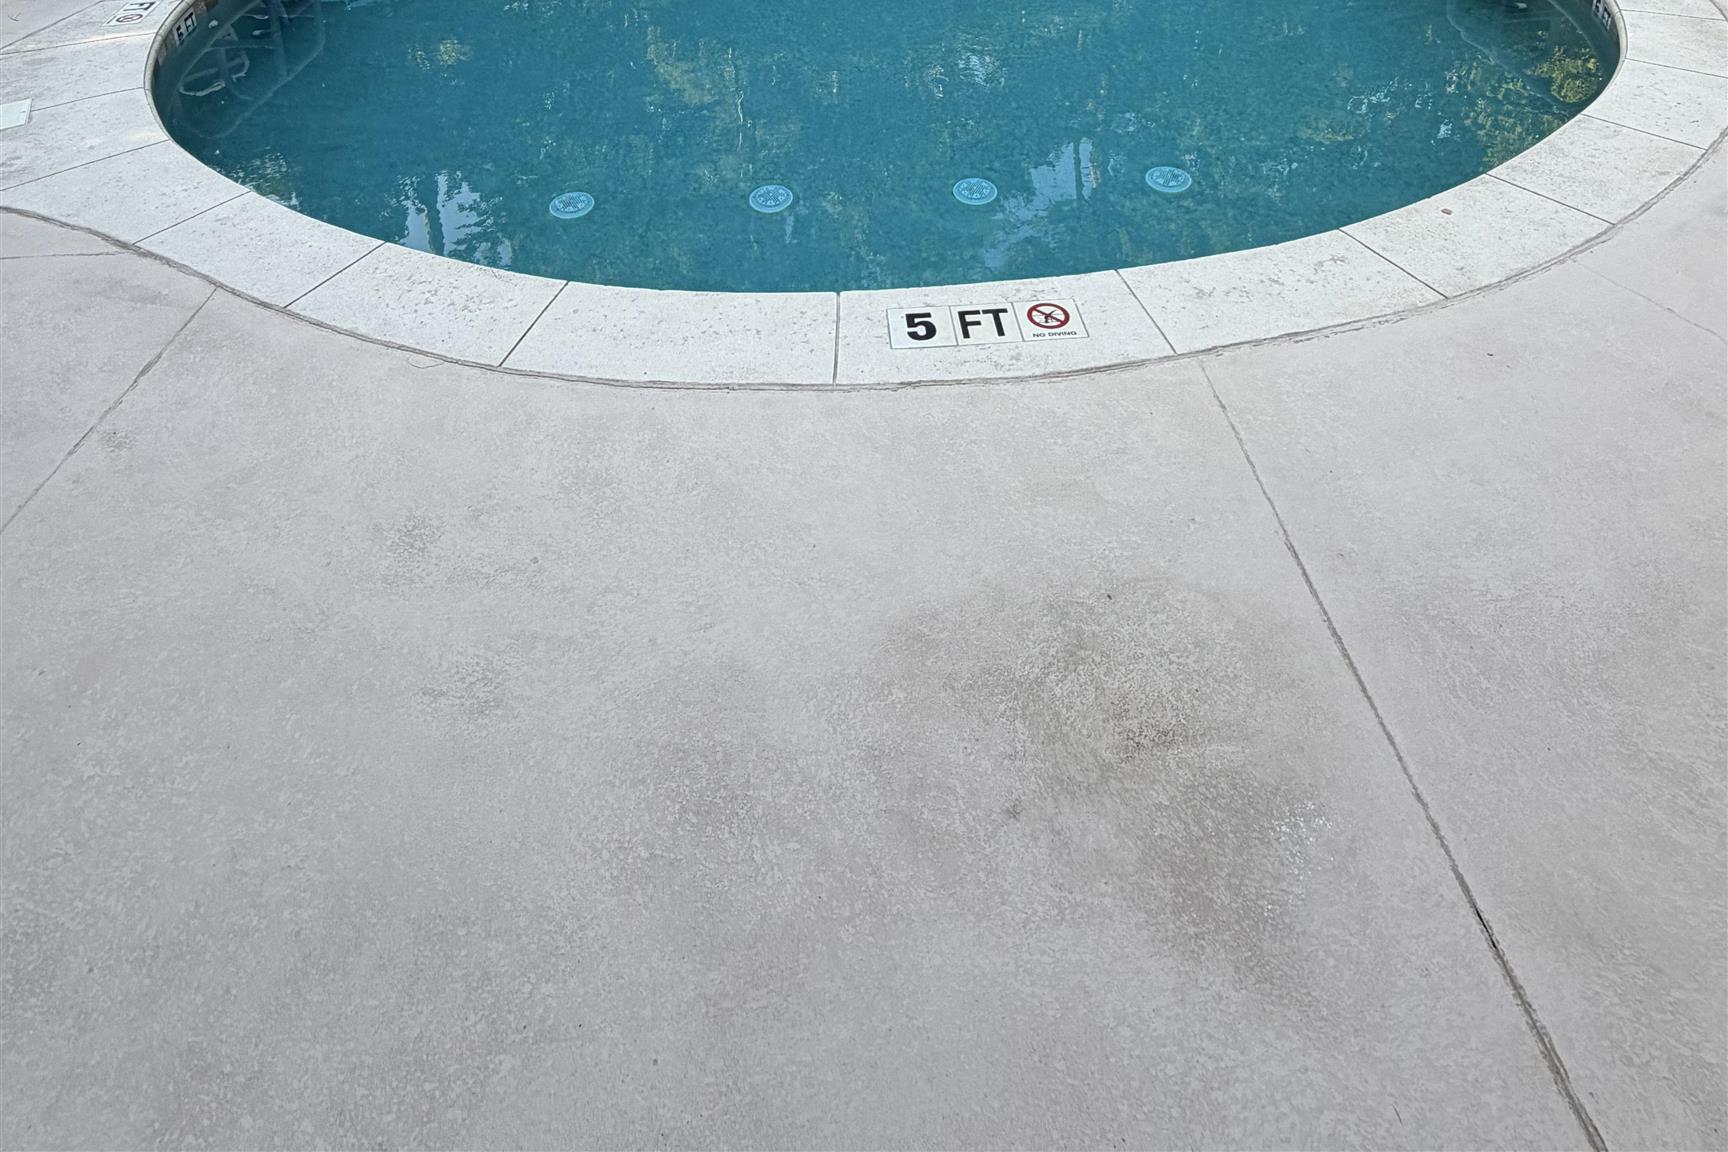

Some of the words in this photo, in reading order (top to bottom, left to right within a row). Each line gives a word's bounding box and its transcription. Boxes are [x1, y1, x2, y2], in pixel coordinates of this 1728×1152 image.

[123, 1, 157, 11] FT
[184, 12, 195, 32] FT
[905, 312, 937, 341] 5
[957, 308, 1008, 339] FT
